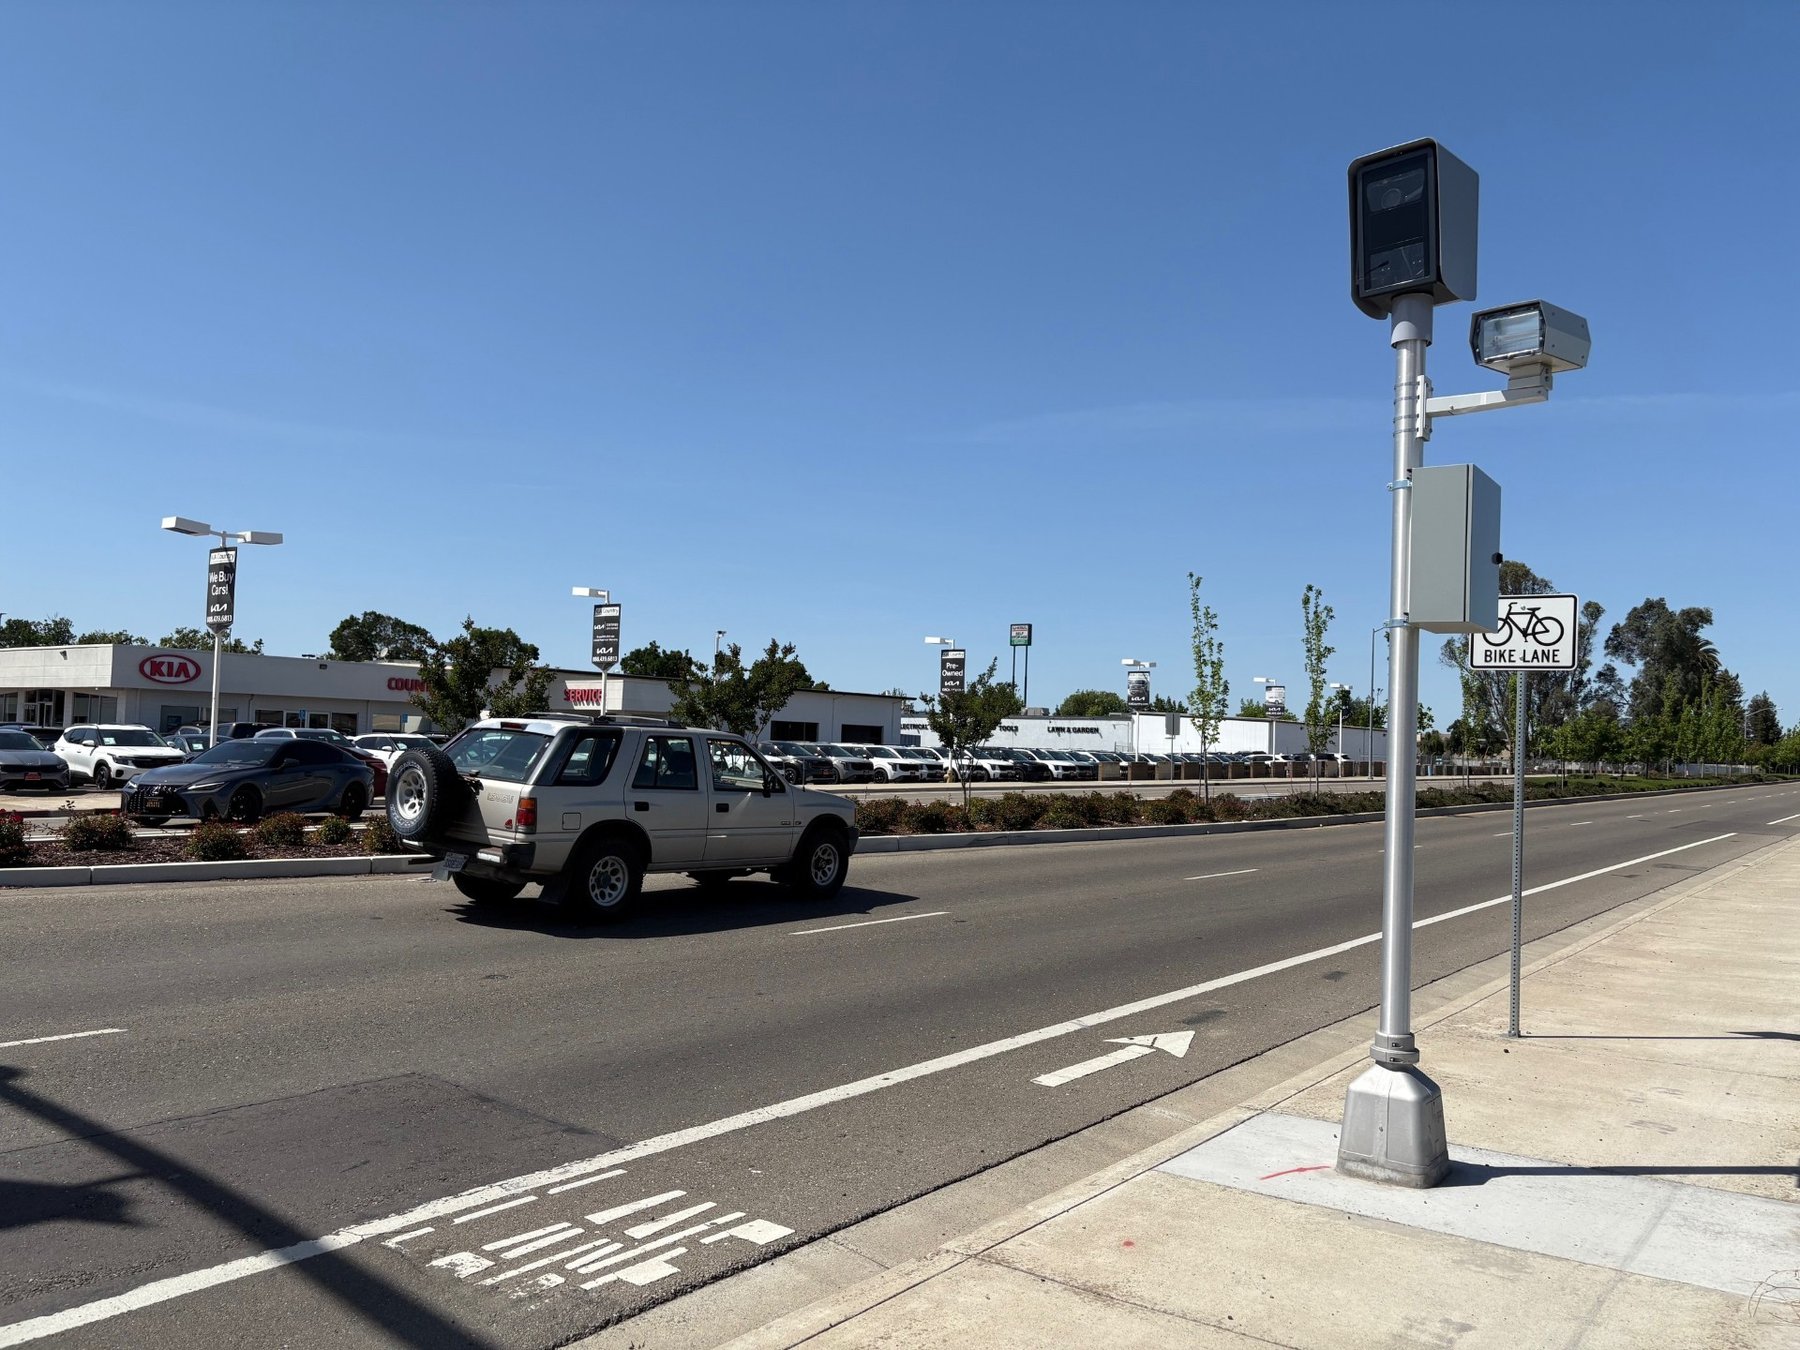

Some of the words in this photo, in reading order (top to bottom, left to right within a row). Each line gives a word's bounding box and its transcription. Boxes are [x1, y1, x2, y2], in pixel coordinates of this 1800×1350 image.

[209, 572, 218, 583] We
[219, 571, 234, 584] Buy
[211, 584, 228, 595] Cars!
[1484, 649, 1516, 663] BIKE
[1522, 649, 1560, 663] LANE
[150, 660, 191, 678] KIA
[946, 662, 959, 670] Pre-
[942, 669, 964, 677] Owned
